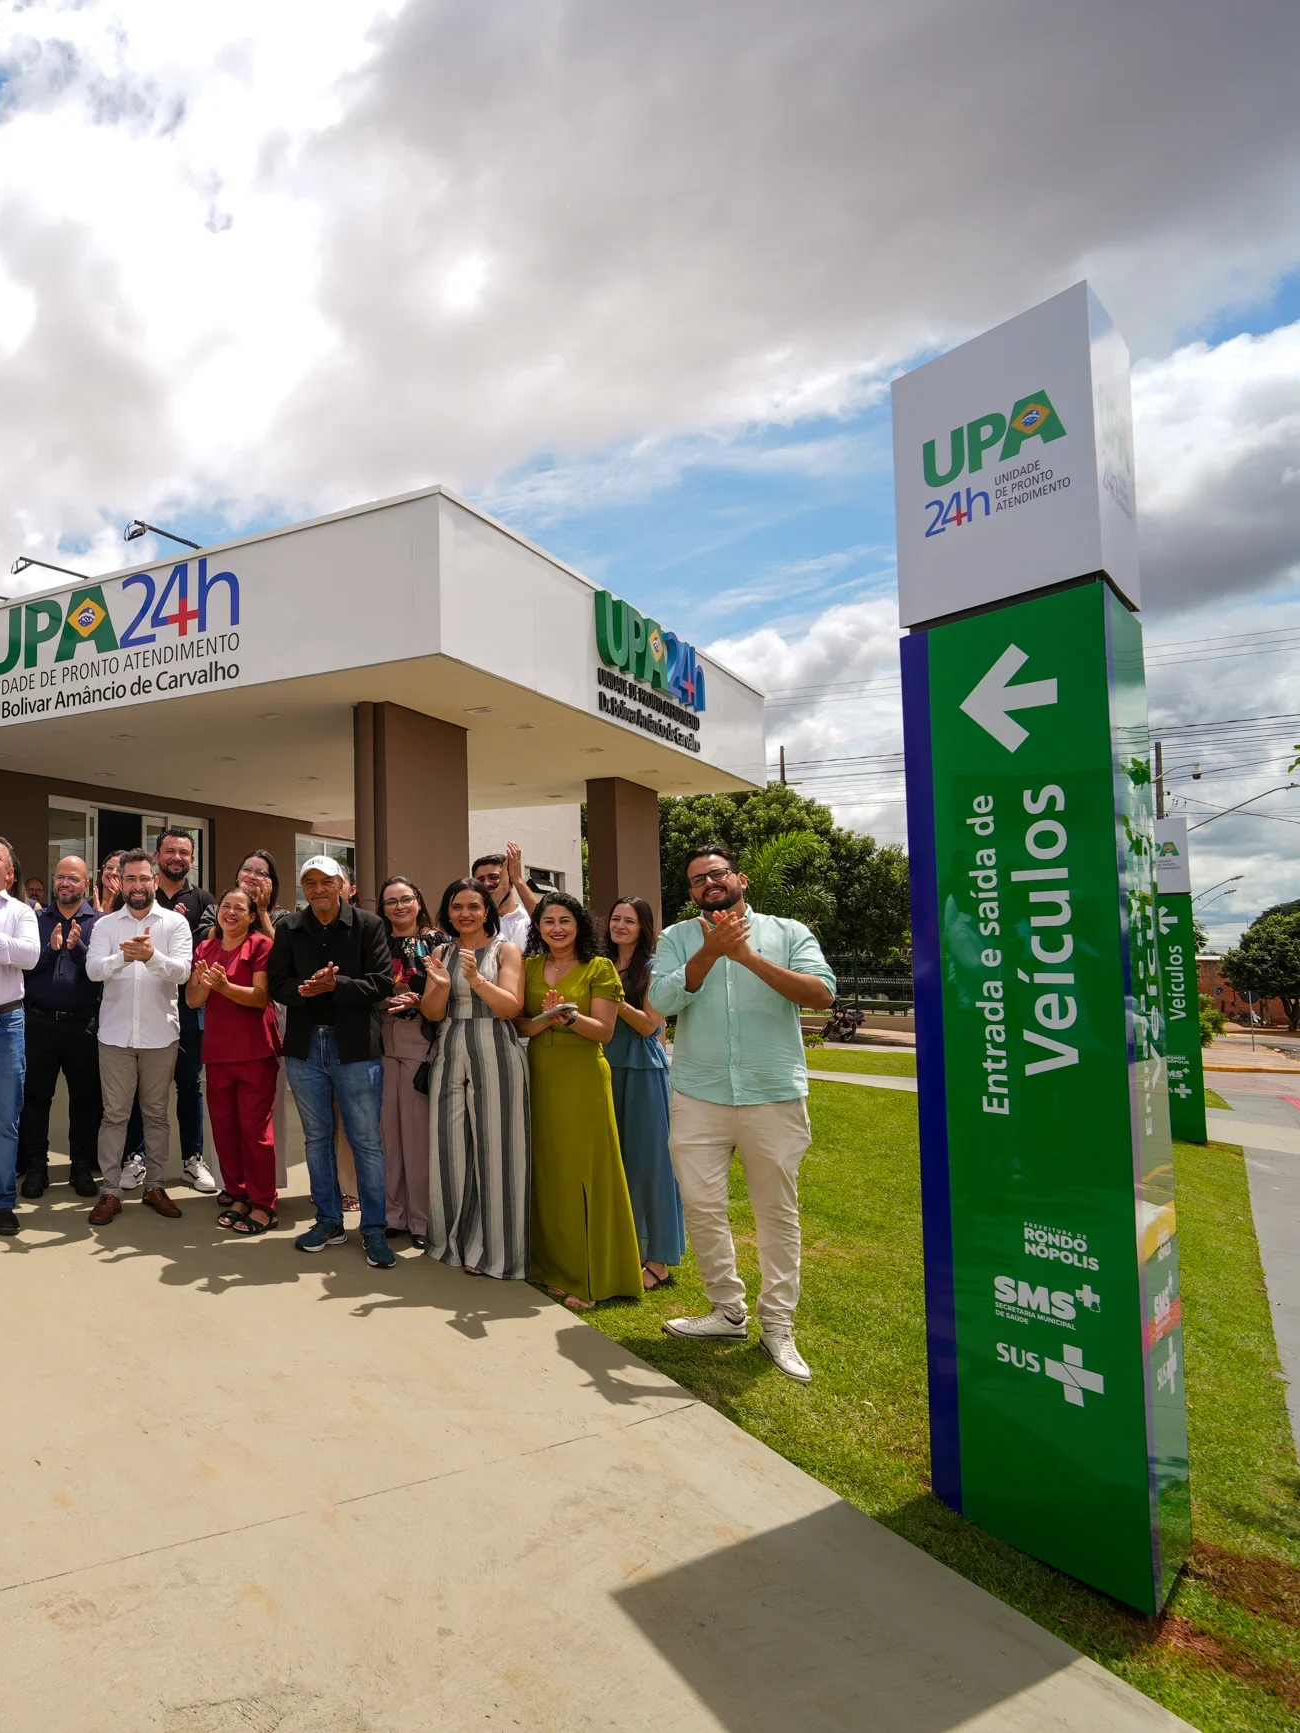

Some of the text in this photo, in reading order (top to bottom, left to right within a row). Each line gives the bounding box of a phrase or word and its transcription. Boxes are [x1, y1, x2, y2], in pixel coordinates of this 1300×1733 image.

[922, 389, 1067, 488] UPA
[994, 459, 1041, 486] UNIDADE
[995, 469, 1054, 499] DE PRONTO
[925, 487, 991, 538] 24h
[996, 476, 1071, 513] ATENDIMENTO
[119, 558, 240, 649] 24h
[41, 670, 57, 688] DE
[62, 657, 119, 684] PRONTO
[123, 632, 240, 672] ATENDIMENTO
[595, 590, 706, 712] UPA 24h
[1, 696, 52, 719] Bolivar
[54, 680, 127, 710] Amâncio
[130, 675, 152, 695] de
[156, 661, 240, 691] Carvalho
[598, 691, 611, 714] Dr.
[1155, 841, 1179, 857] PA
[1010, 784, 1080, 1077] Veículos
[966, 795, 1010, 1115] Entrada e saída de
[1165, 944, 1186, 1021] Veículos
[1168, 1070, 1183, 1078] MS
[1023, 1221, 1072, 1237] PREFEITURA
[1024, 1227, 1088, 1253] RONDO
[994, 1275, 1076, 1321] SMS
[994, 1301, 1077, 1331] SECRETARIA MUNICIPAL
[995, 1309, 1005, 1317] DE
[996, 1342, 1041, 1373] SUS
